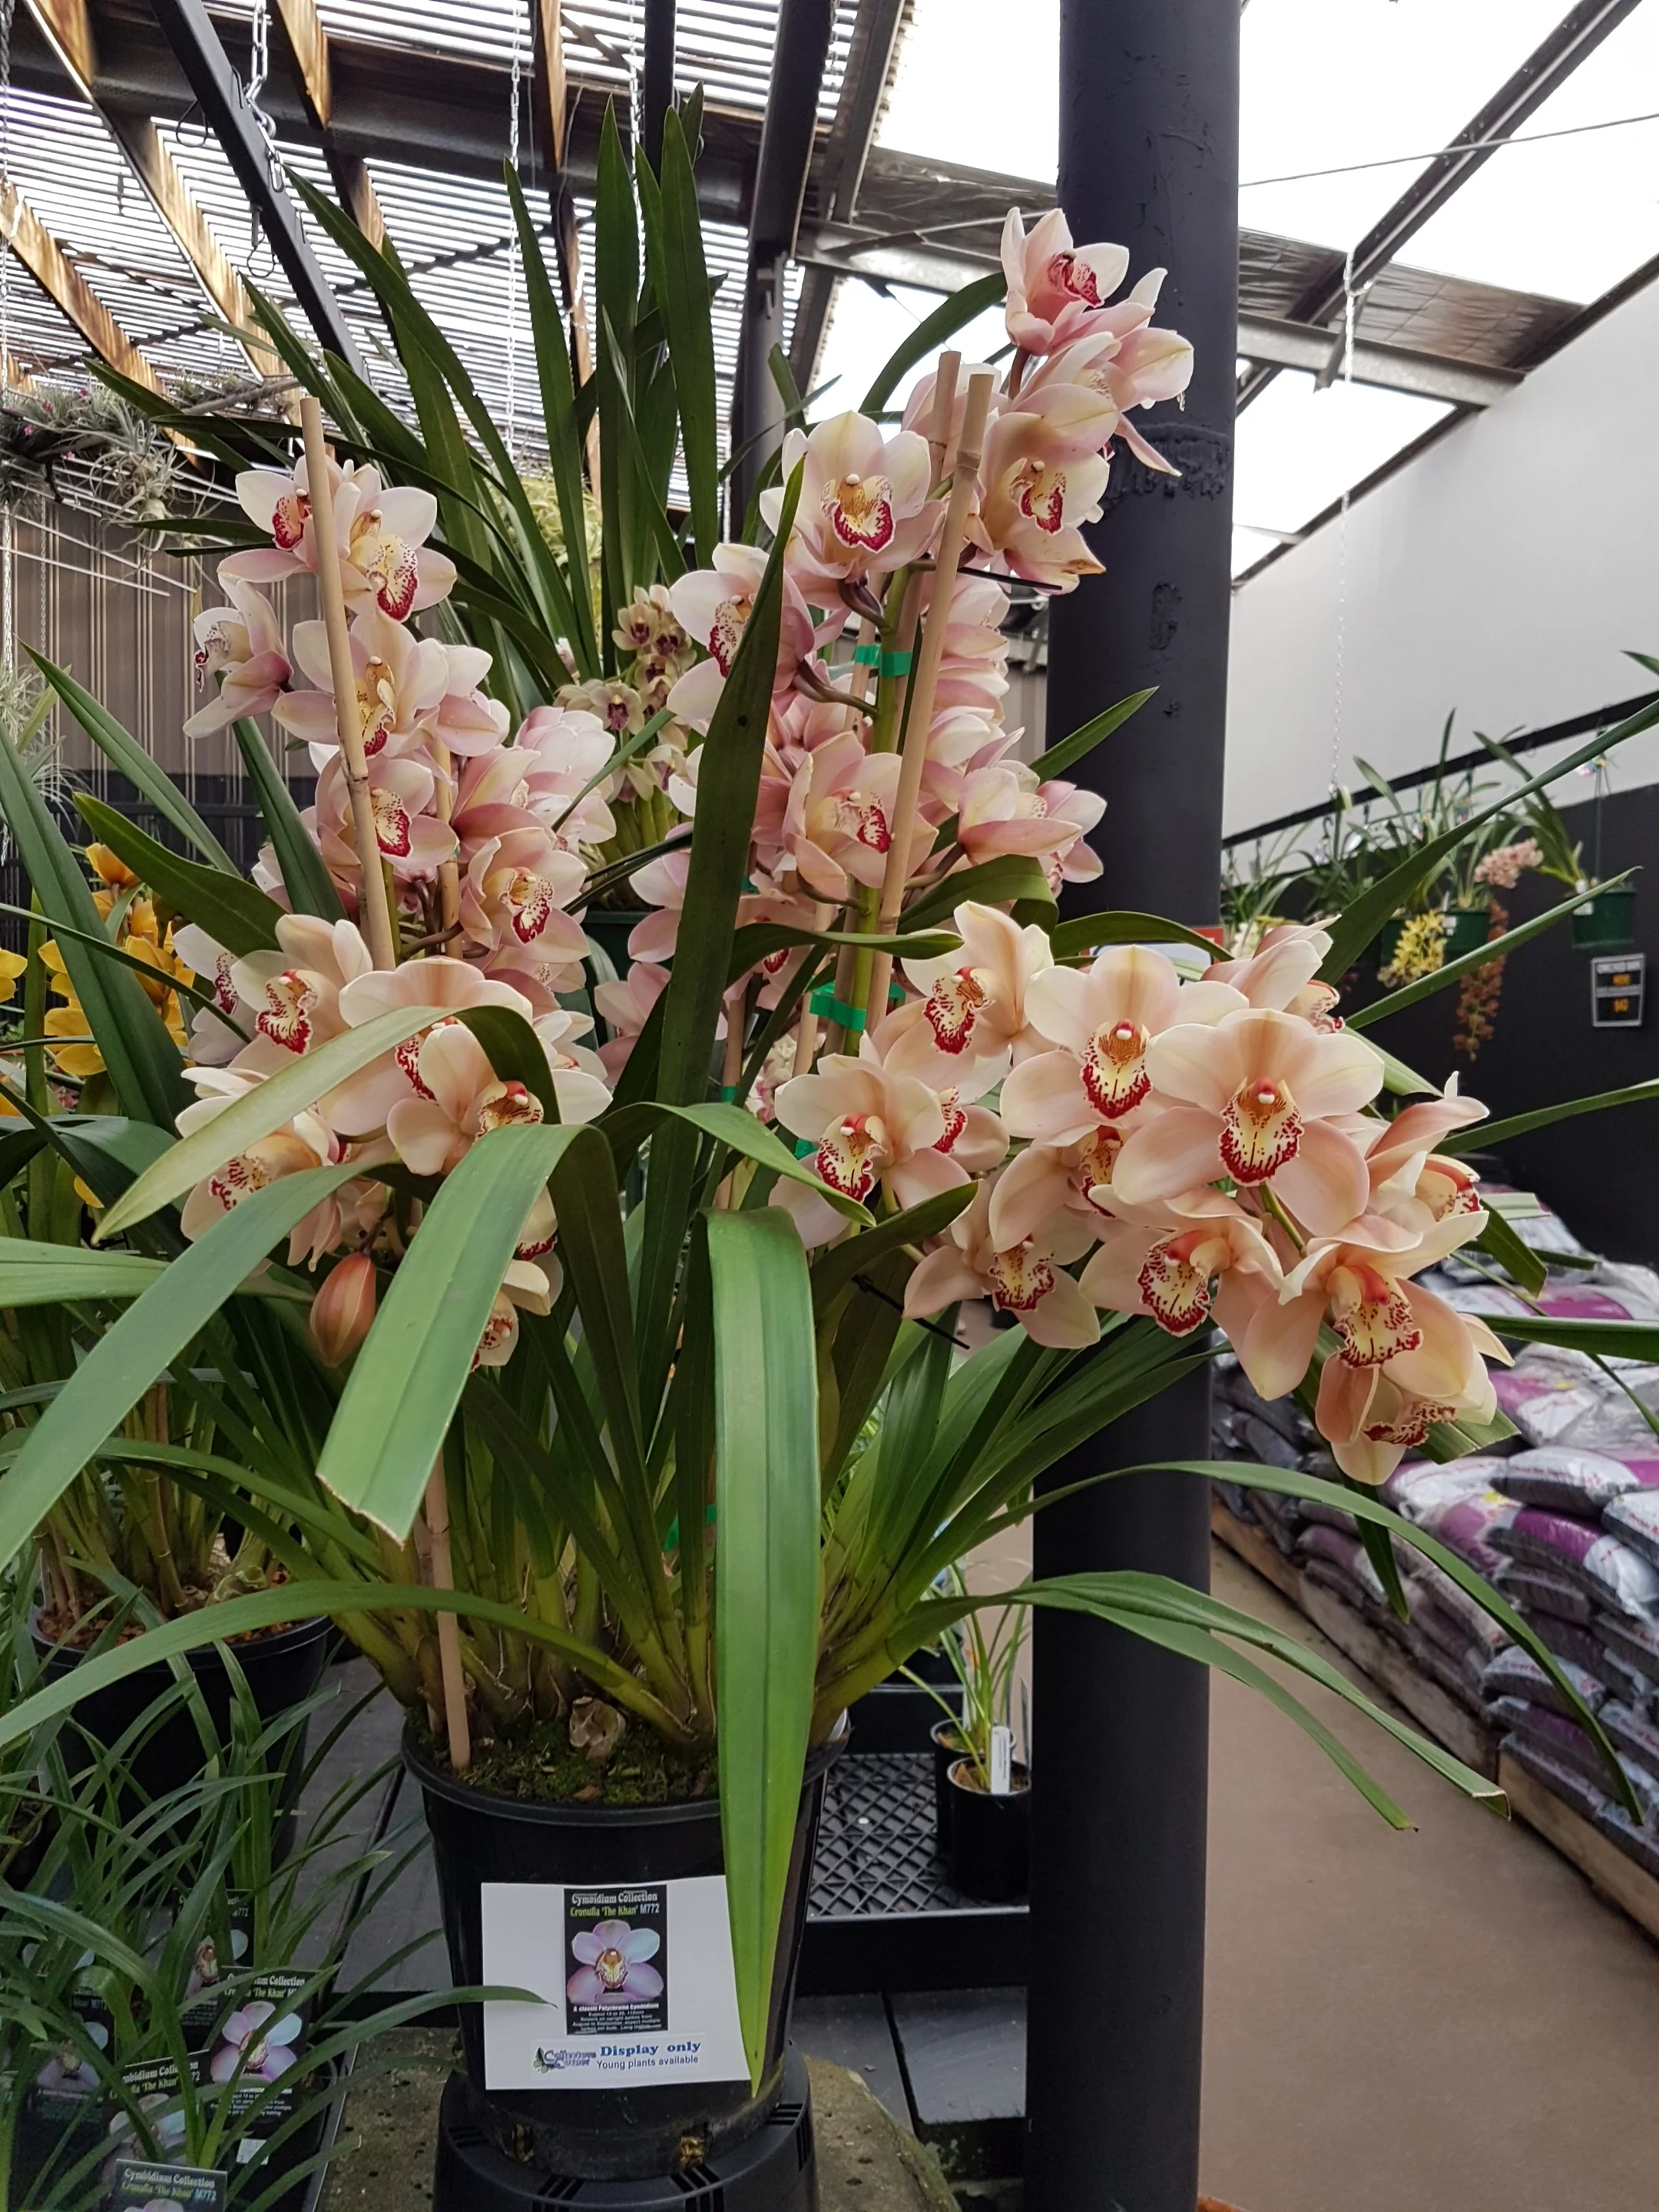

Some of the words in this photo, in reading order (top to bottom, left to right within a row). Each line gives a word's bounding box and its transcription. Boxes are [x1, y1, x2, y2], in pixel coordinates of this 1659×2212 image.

[618, 1891, 657, 1903] Collection
[571, 1906, 600, 1917] Cronulla
[640, 1902, 660, 1914] M772
[600, 2044, 659, 2058] Display
[667, 2041, 701, 2054] only
[597, 2058, 626, 2070] Young
[628, 2056, 655, 2069] plants
[658, 2054, 698, 2065] available
[123, 2069, 158, 2084] mbidium
